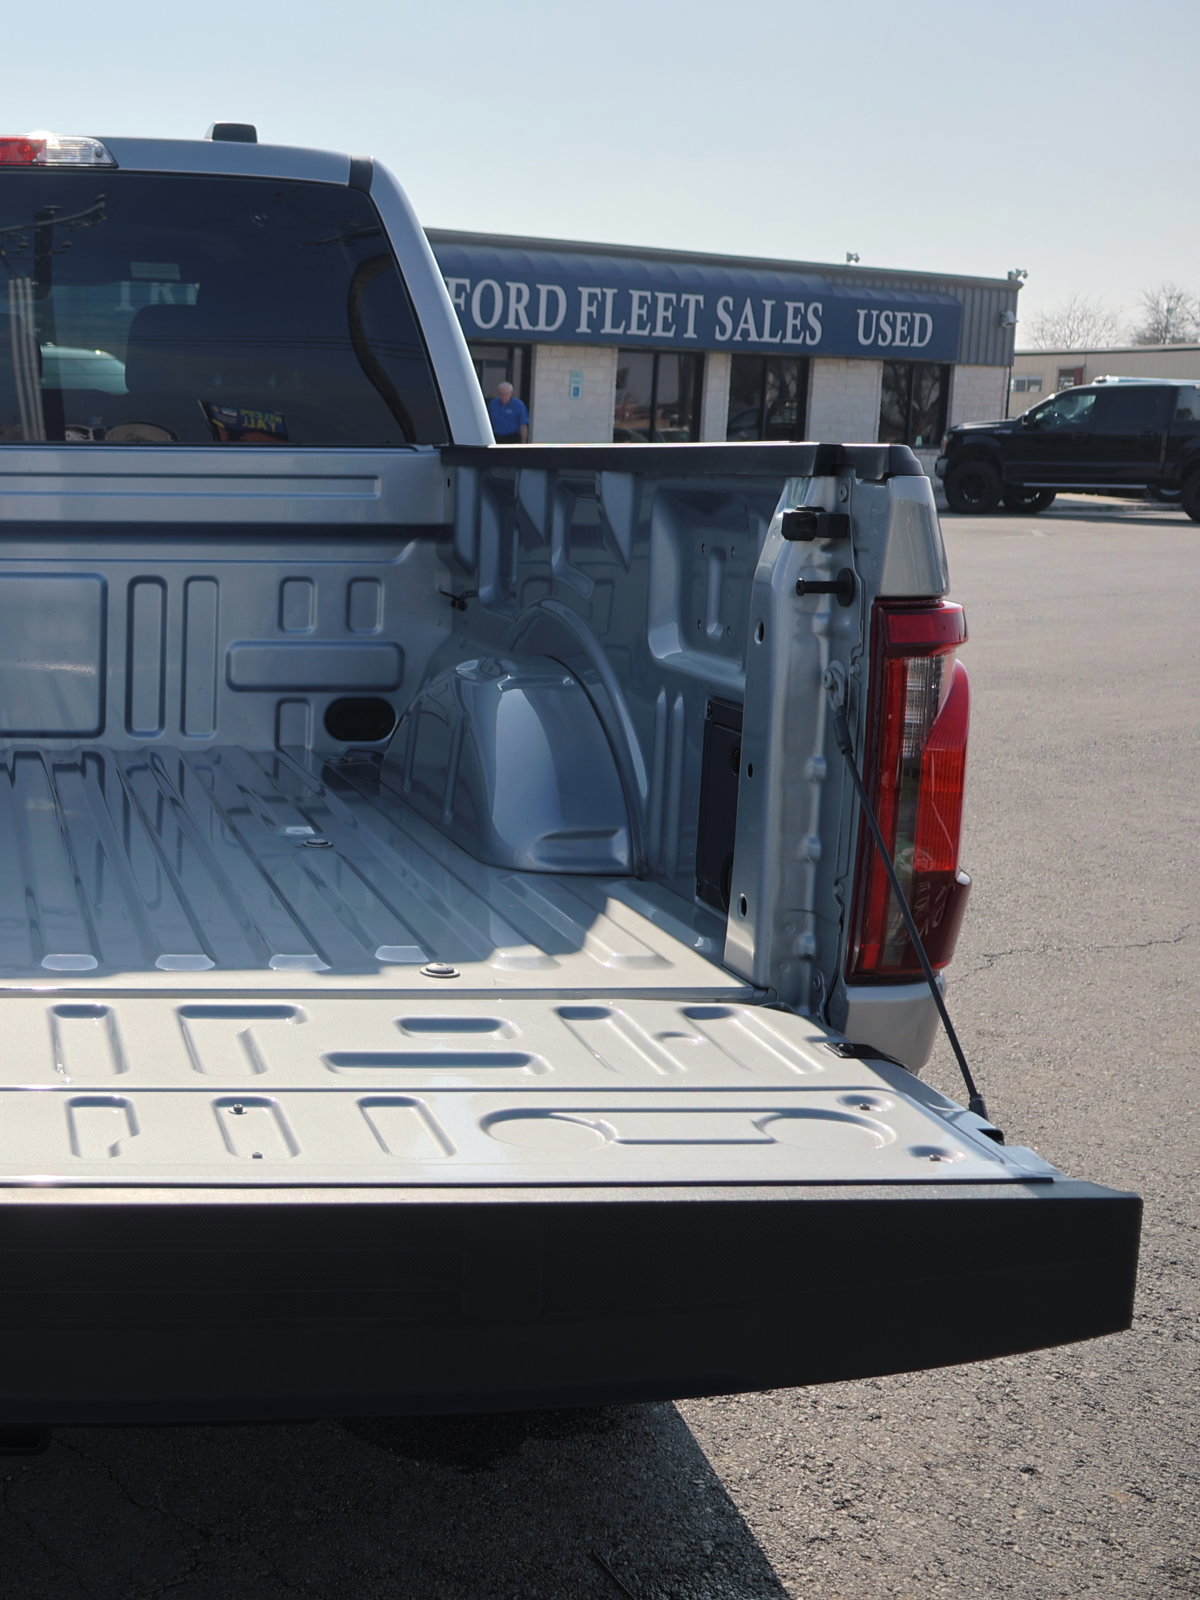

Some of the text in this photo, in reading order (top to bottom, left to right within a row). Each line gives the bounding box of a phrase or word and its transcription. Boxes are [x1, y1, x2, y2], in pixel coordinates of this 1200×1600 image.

[445, 277, 823, 346] FORD FLEET SALES
[857, 309, 934, 348] USED
